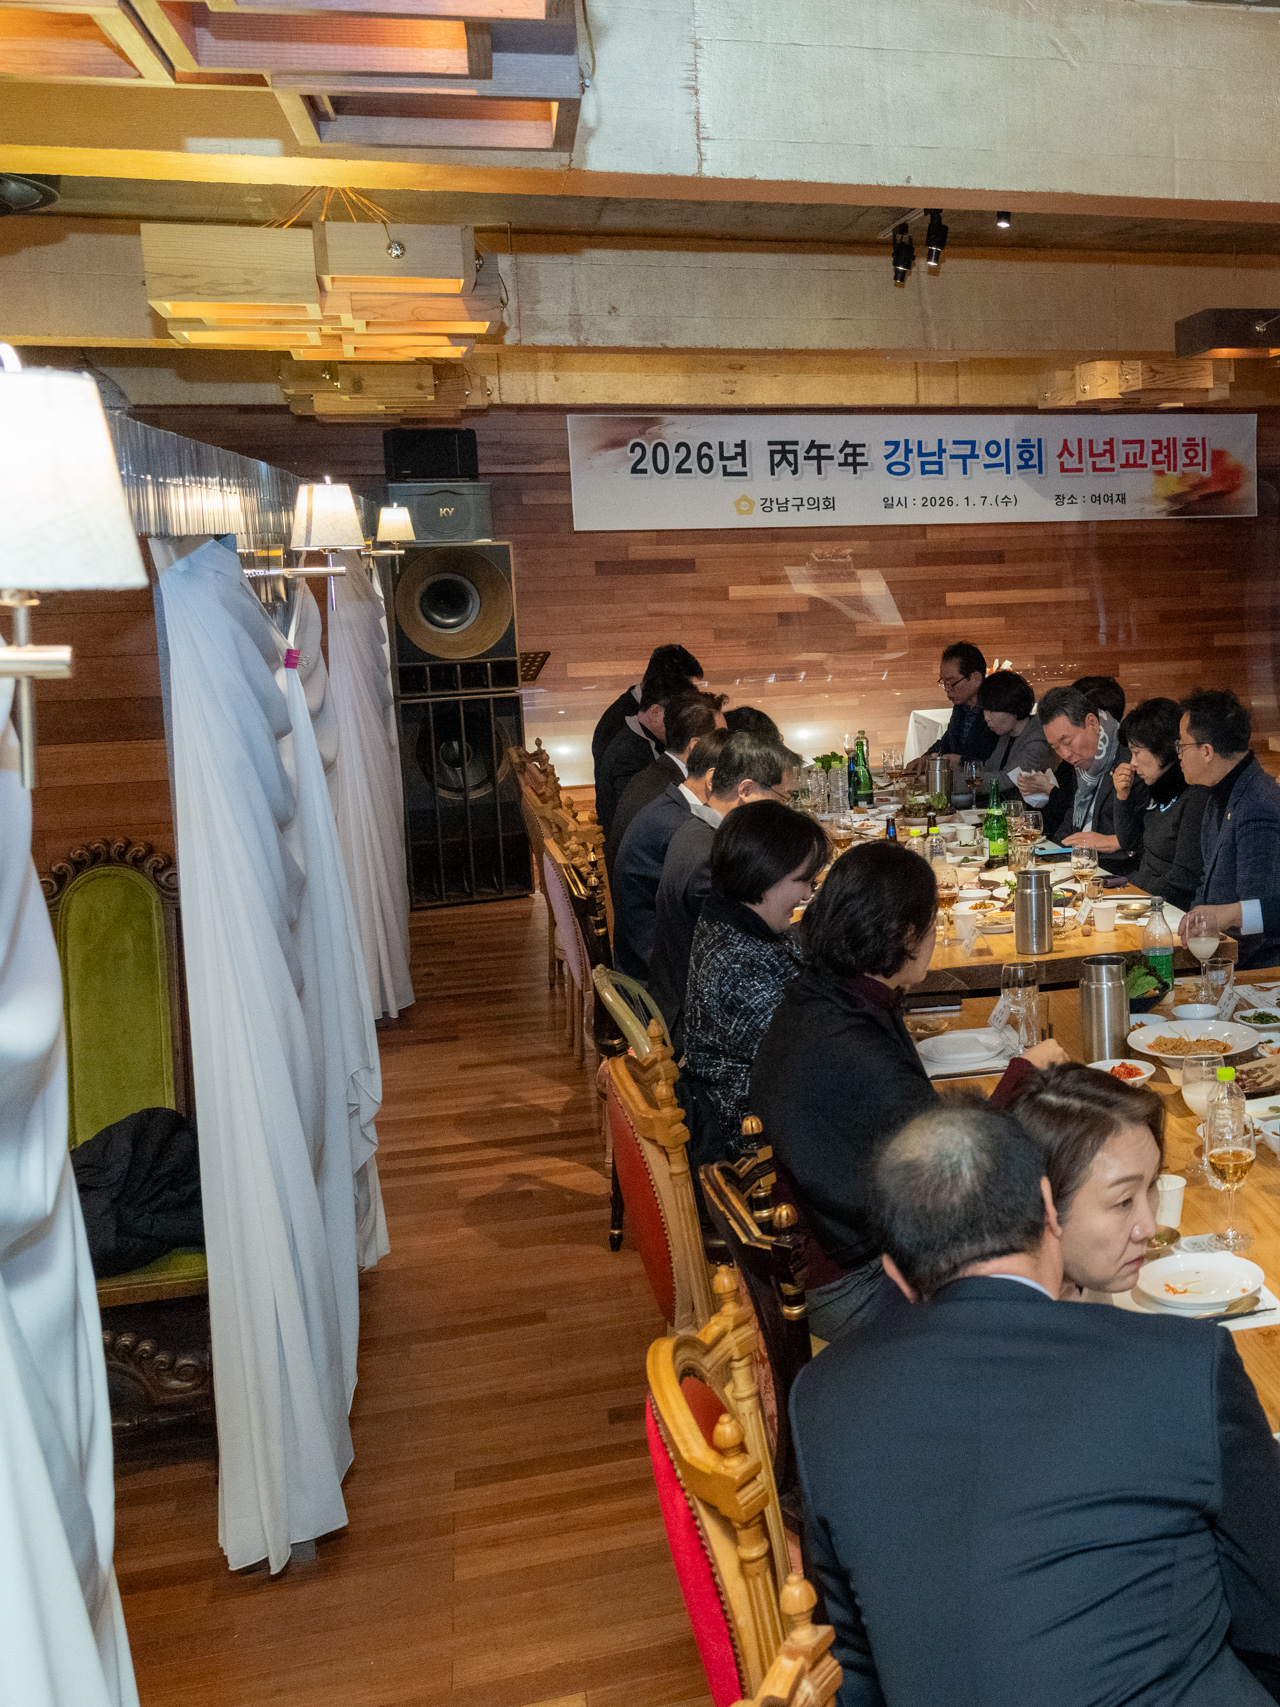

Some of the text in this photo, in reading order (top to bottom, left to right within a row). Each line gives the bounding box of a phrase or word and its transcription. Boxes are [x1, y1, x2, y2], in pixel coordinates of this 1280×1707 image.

[629, 436, 1207, 477] 2026년 丙午年 강남구의회 신년교례회
[759, 496, 836, 513] 강남구의회
[882, 496, 908, 509] 일시
[1054, 493, 1079, 506] 장소
[1090, 492, 1126, 505] 여여재
